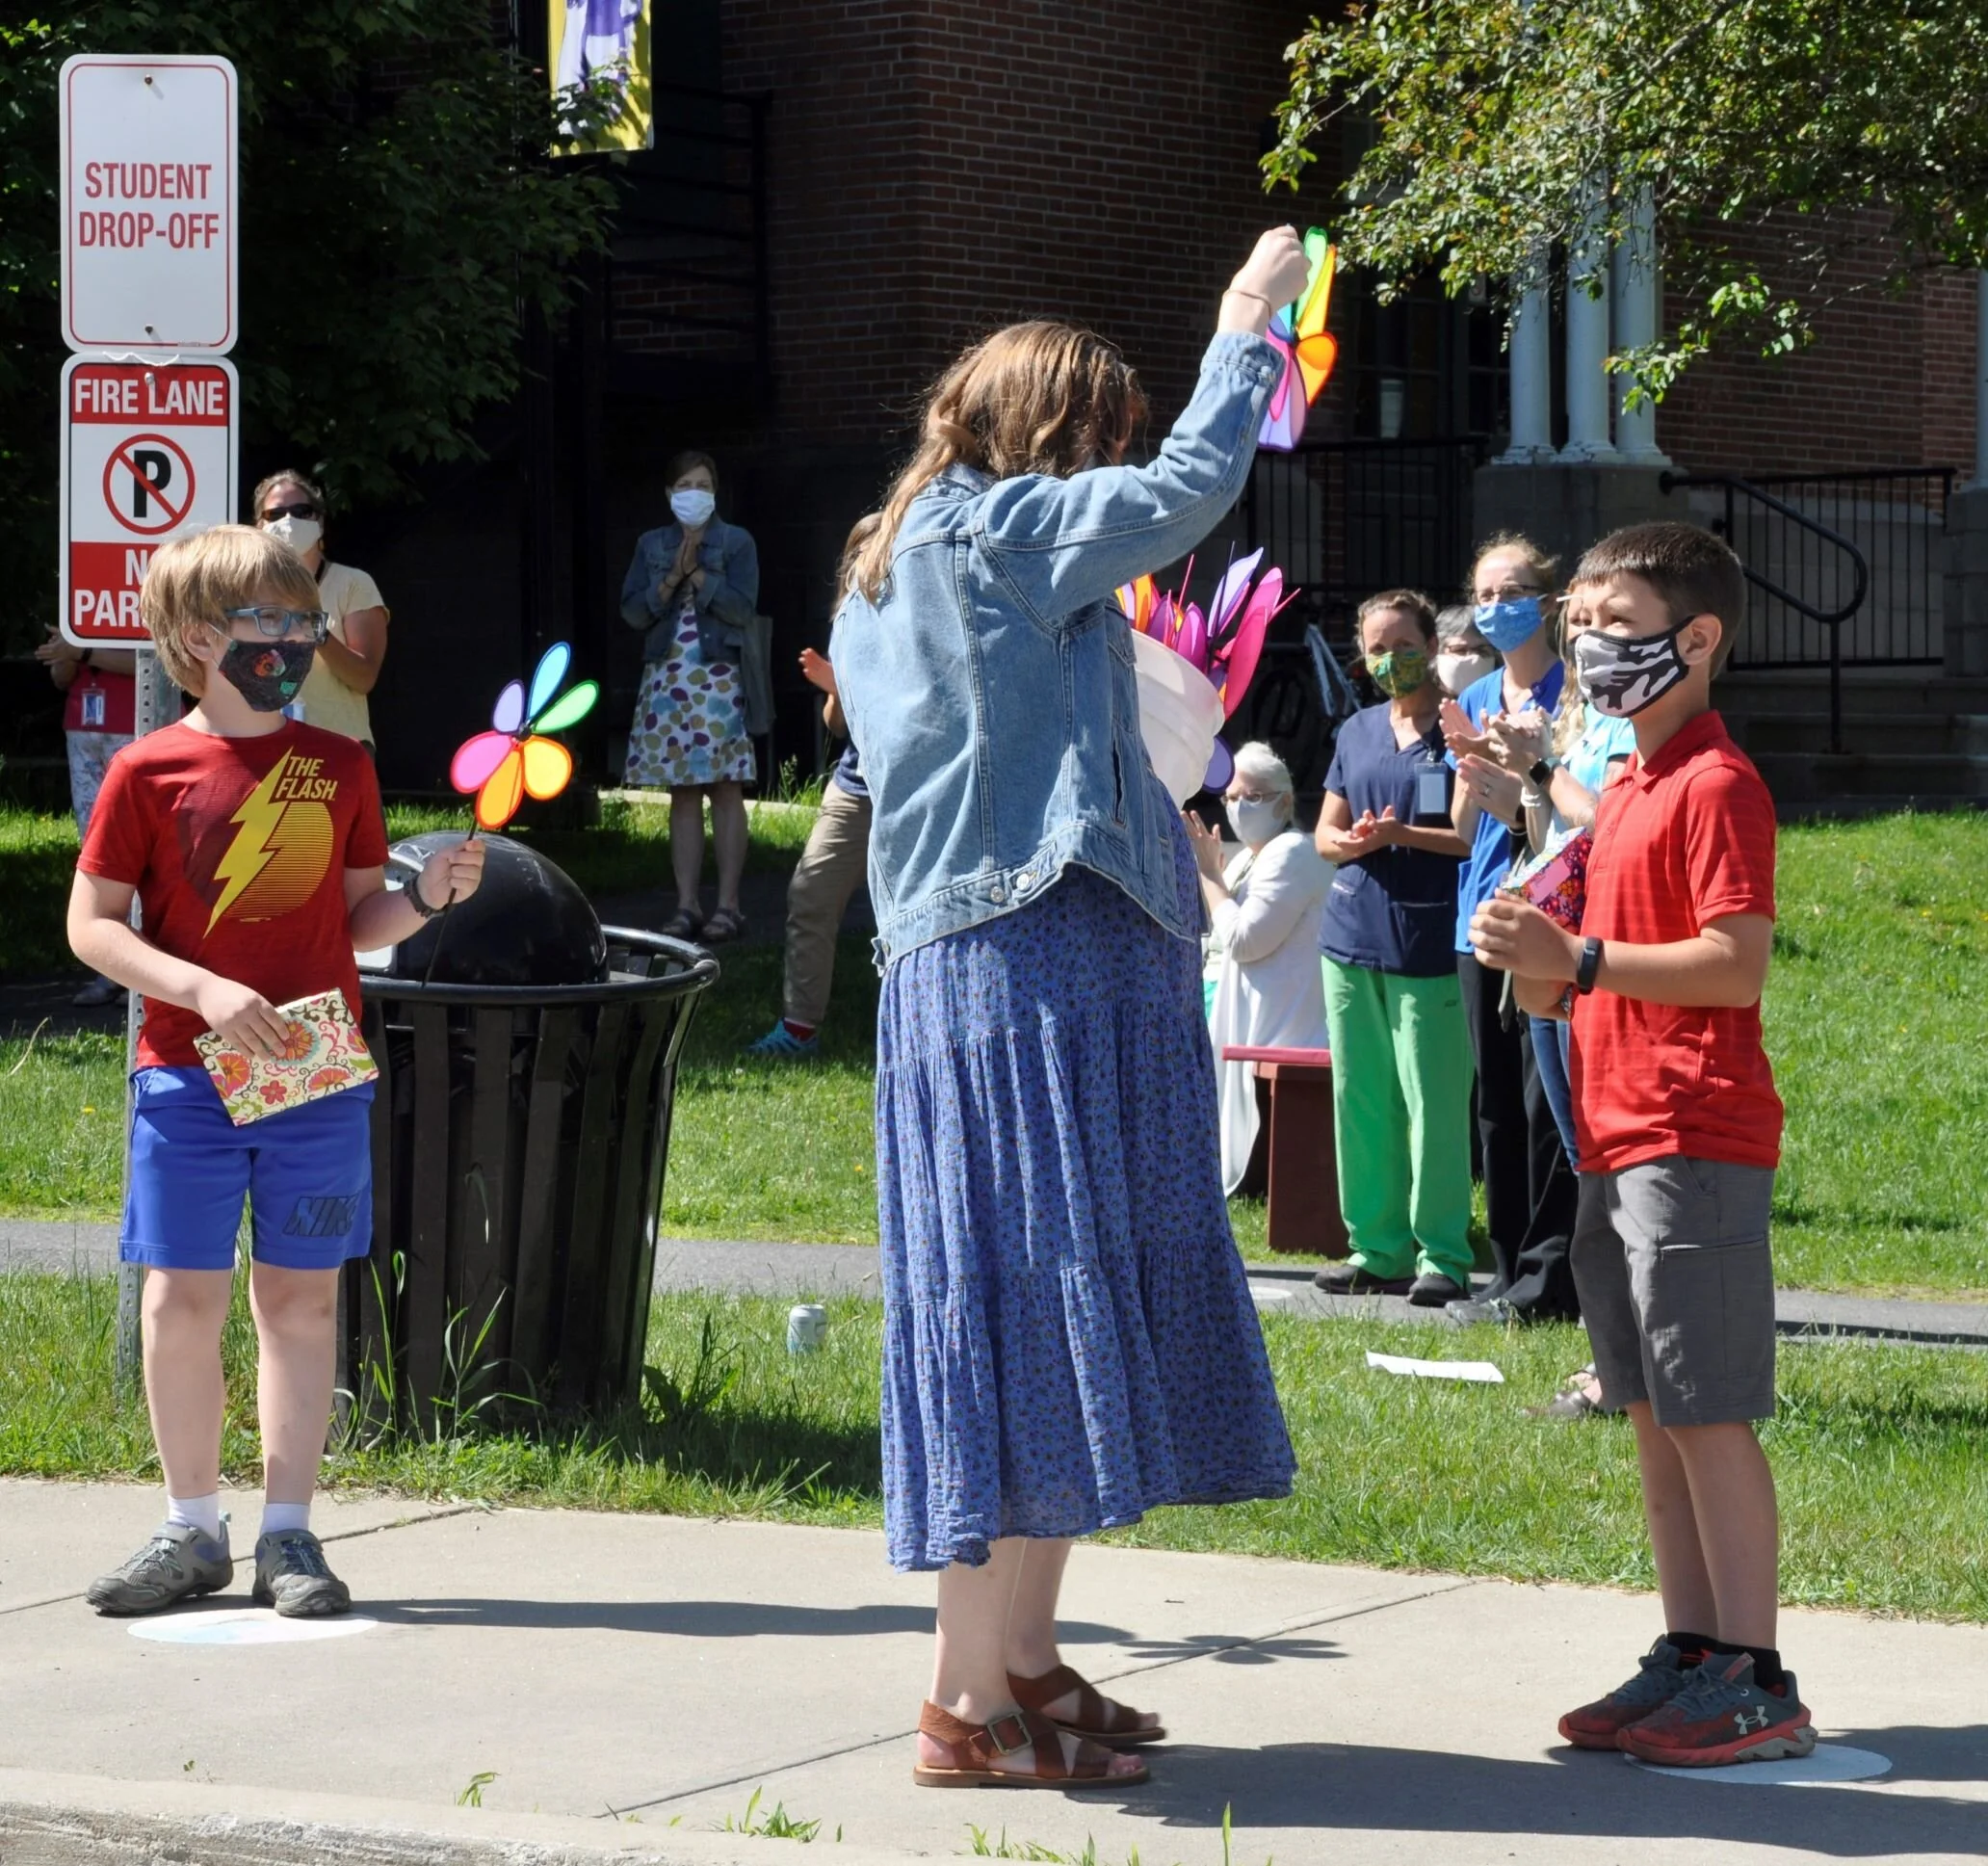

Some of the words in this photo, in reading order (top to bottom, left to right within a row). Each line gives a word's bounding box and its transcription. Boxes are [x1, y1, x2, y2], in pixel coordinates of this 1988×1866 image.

[85, 162, 212, 199] STUDENT
[79, 211, 219, 249] DROP-OFF
[74, 378, 139, 414] FIRE
[147, 381, 223, 415] LANE
[133, 449, 171, 518] P
[125, 549, 150, 586] N
[74, 589, 144, 626] PAR
[286, 755, 325, 776] THE
[275, 777, 338, 801] FLASH
